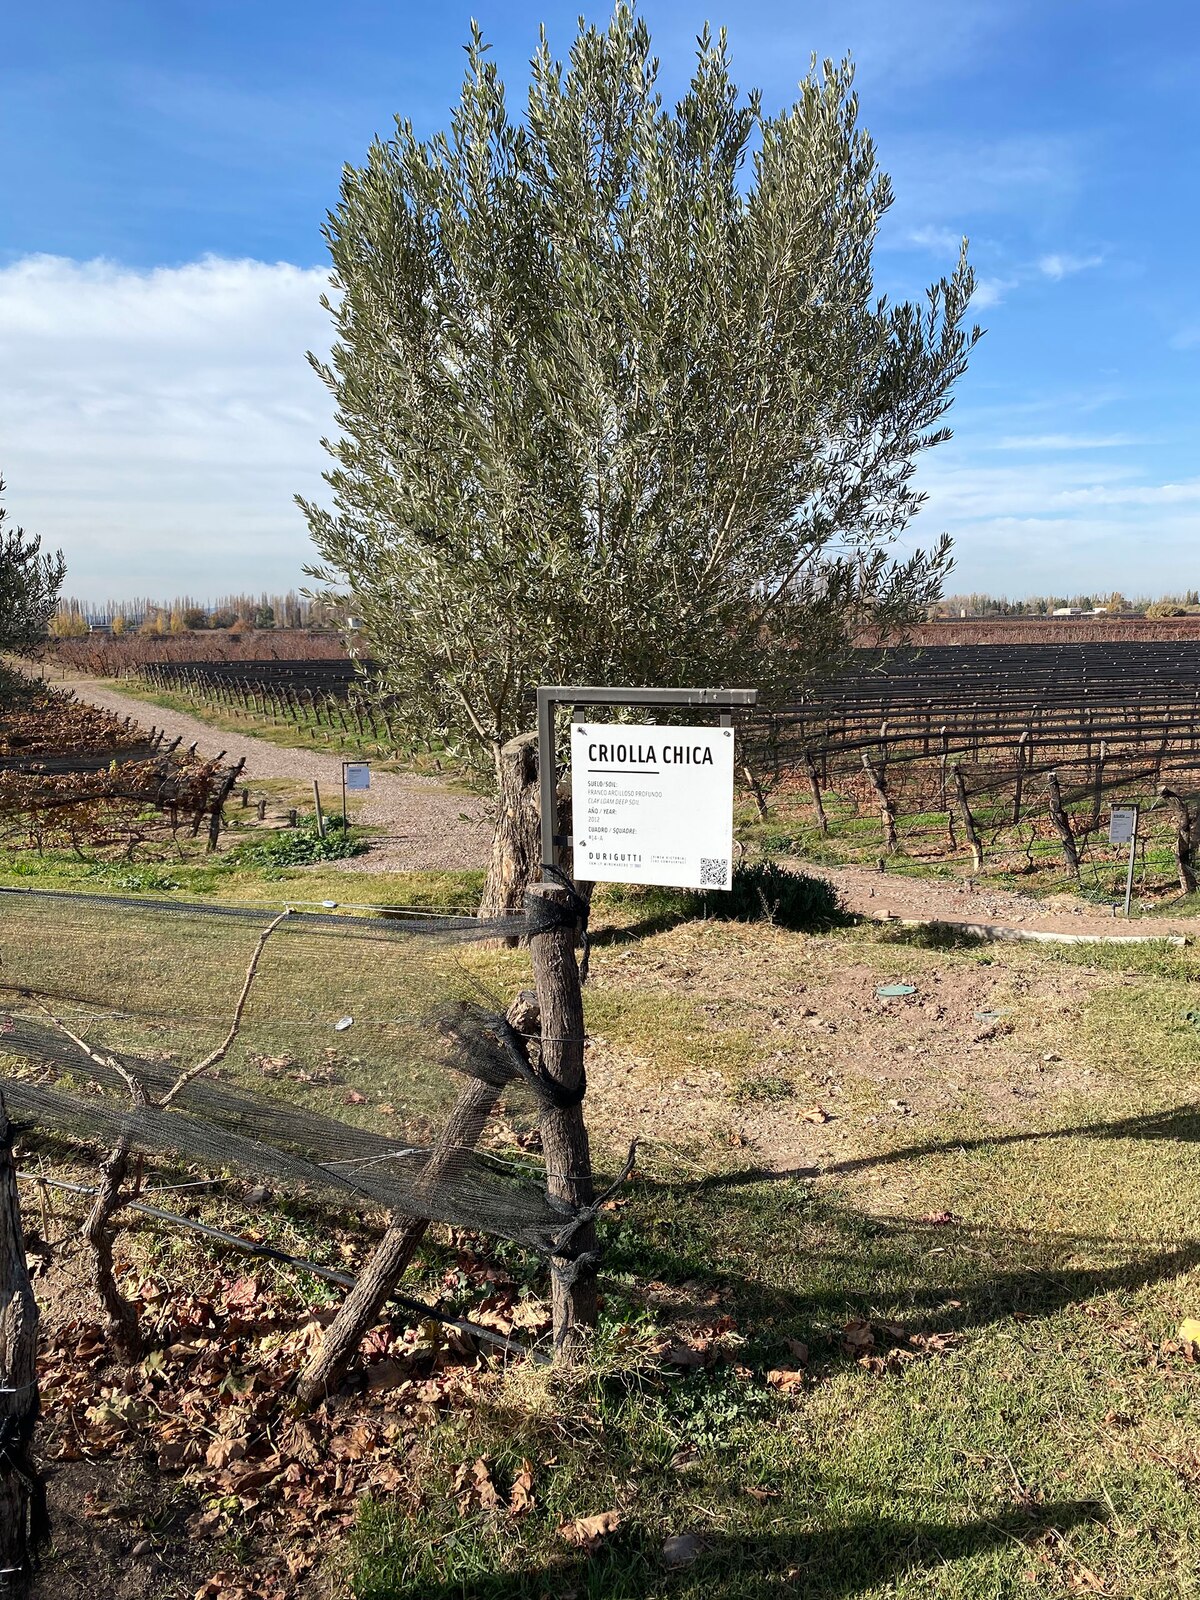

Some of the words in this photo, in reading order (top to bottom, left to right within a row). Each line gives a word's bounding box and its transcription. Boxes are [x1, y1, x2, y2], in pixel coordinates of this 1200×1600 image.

[589, 743, 657, 764] CRIOLLA
[662, 745, 714, 765] CHICA
[608, 789, 635, 797] ARCILLOSO
[635, 790, 663, 798] PROFUNDO
[588, 852, 642, 862] DURIGUTTI
